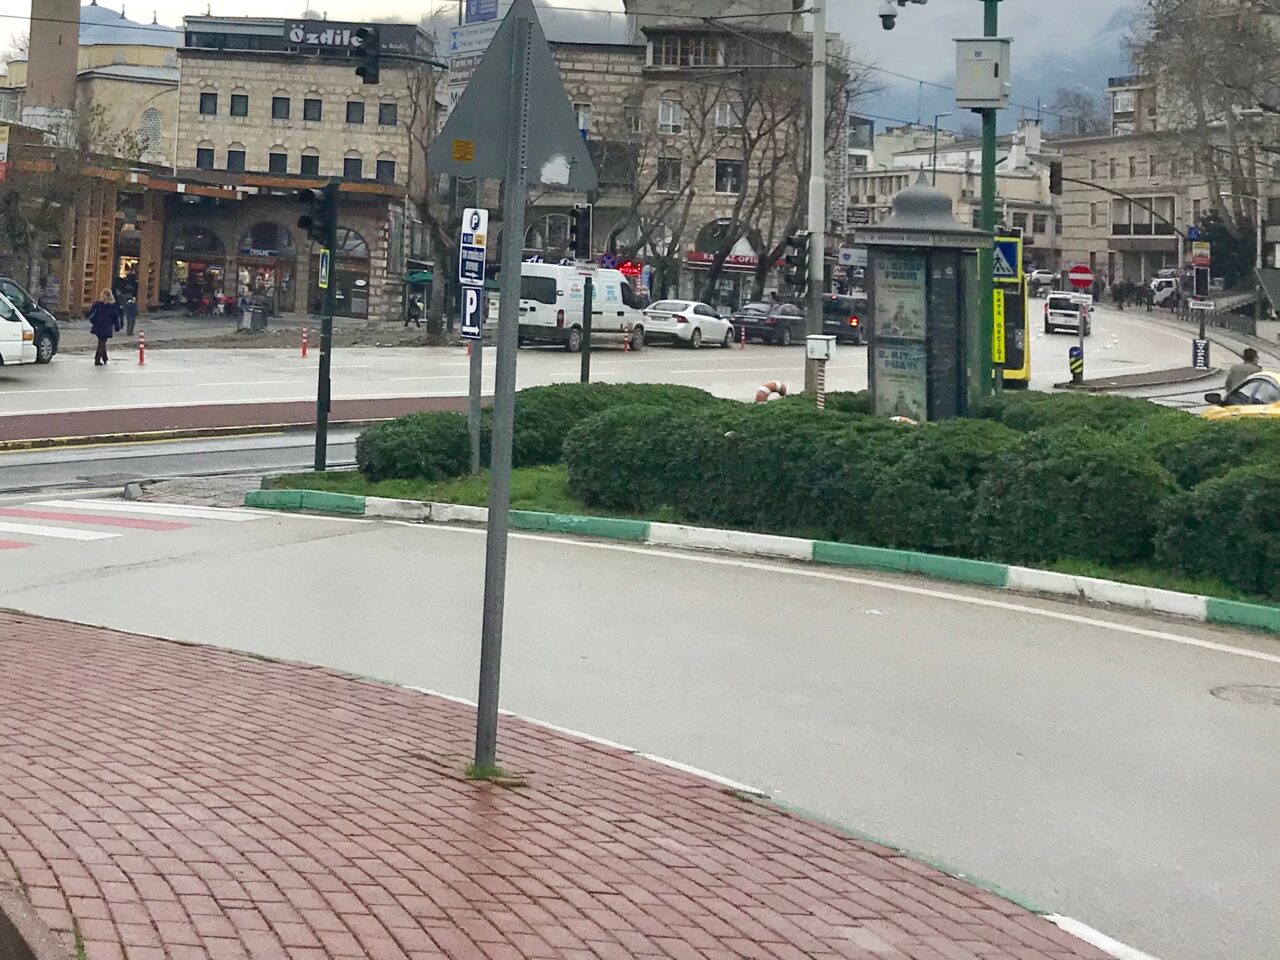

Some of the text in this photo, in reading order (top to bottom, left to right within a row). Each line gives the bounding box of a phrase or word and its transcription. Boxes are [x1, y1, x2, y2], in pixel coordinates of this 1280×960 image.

[289, 23, 364, 48] Özdile
[471, 214, 479, 228] P
[466, 289, 477, 326] P
